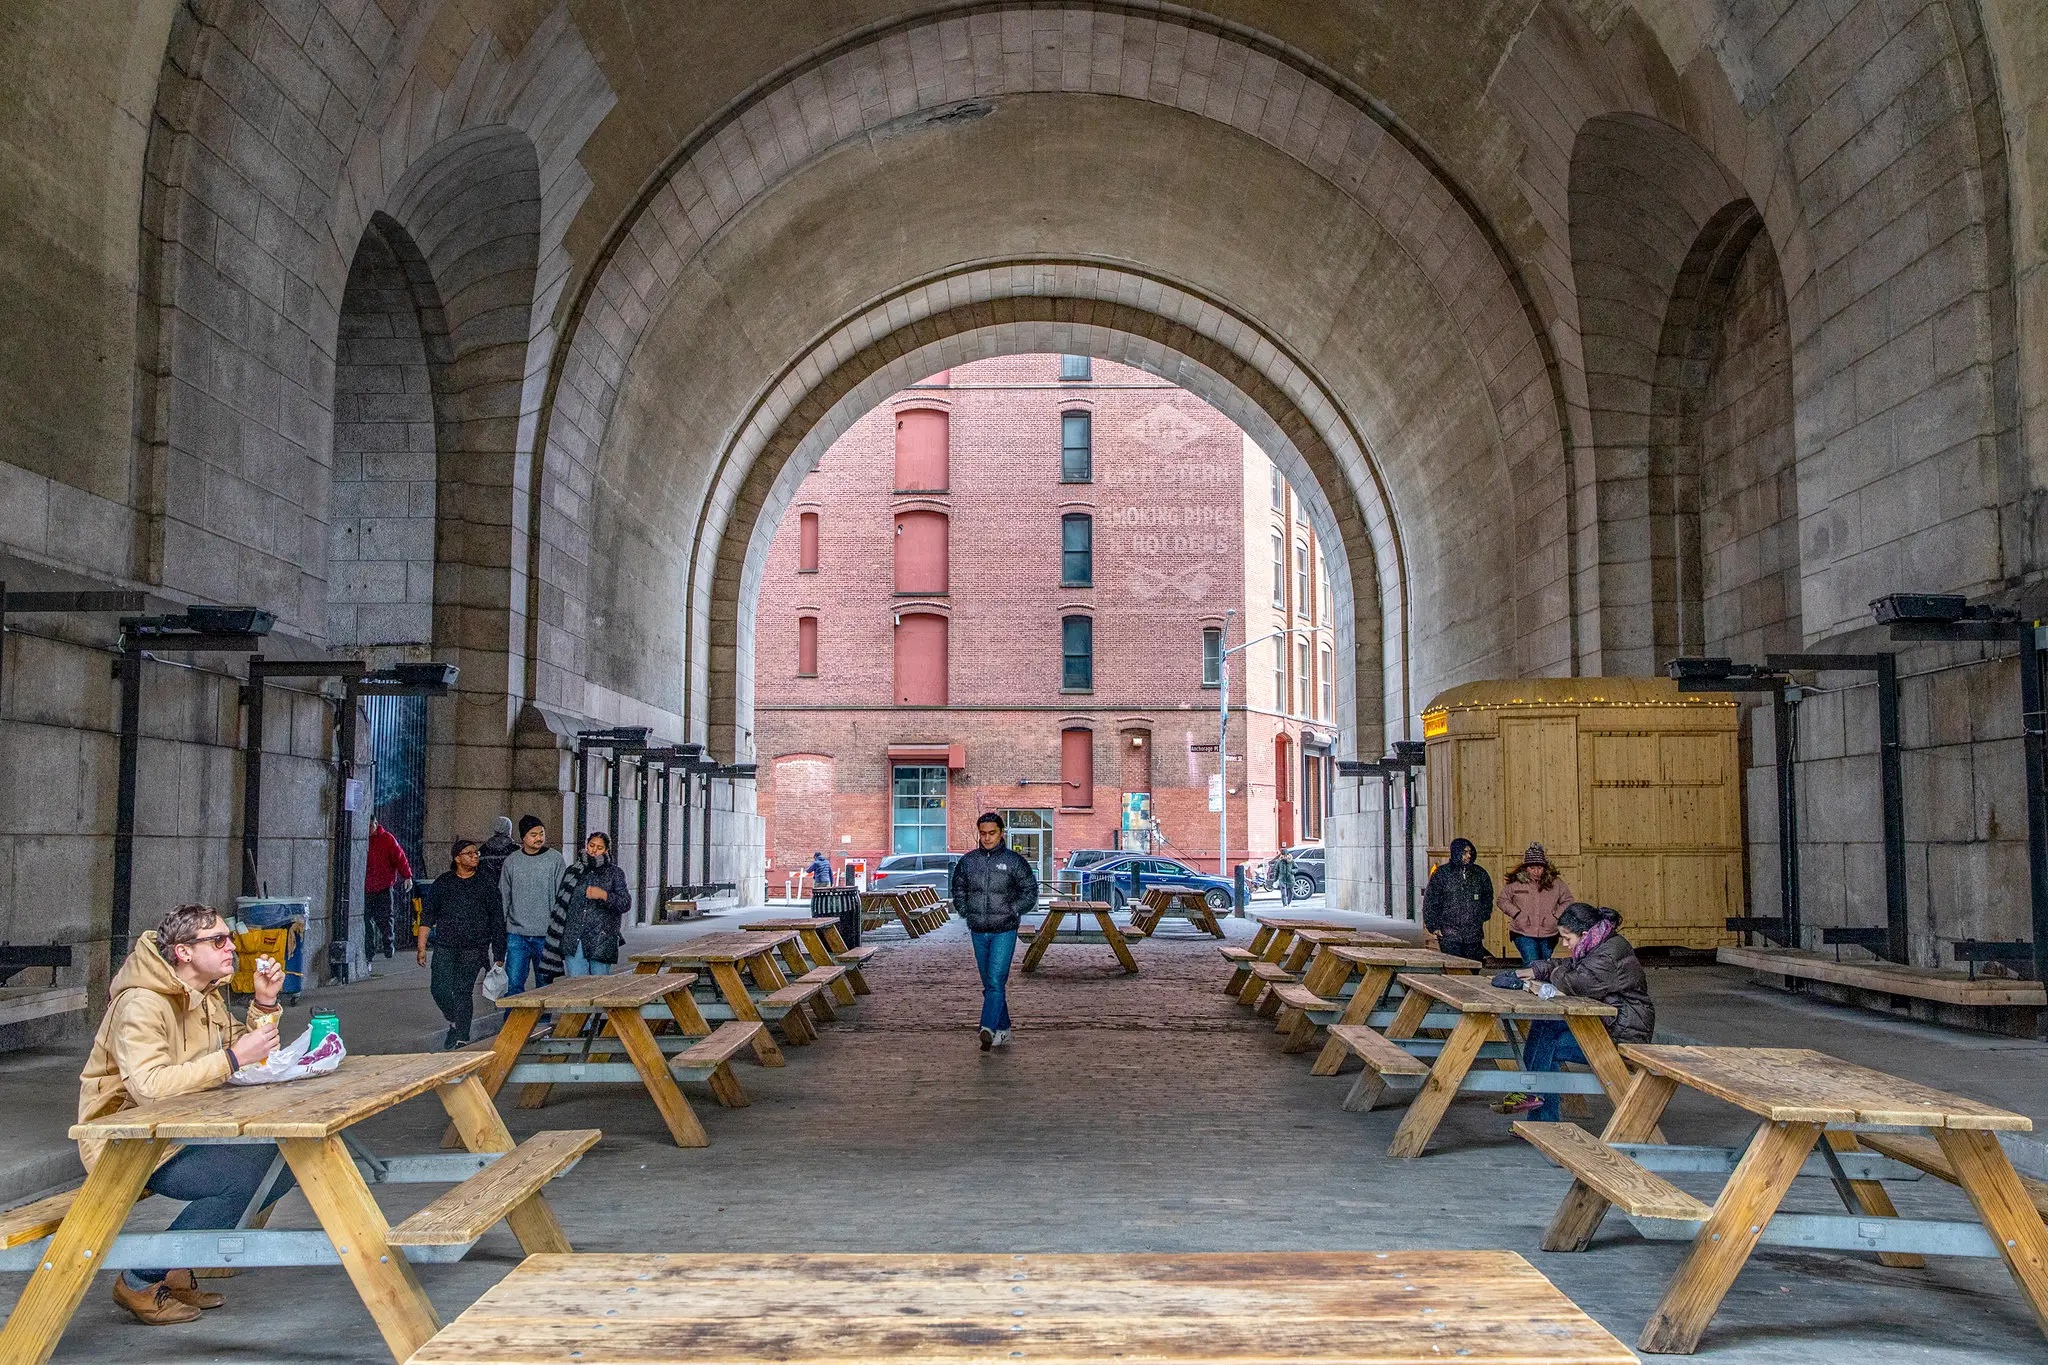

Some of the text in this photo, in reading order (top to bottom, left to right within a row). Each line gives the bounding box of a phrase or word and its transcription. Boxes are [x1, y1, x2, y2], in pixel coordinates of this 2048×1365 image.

[1101, 506, 1236, 526] SMOKING PIPES
[1132, 534, 1228, 555] HOLDERS
[1018, 814, 1033, 822] 155
